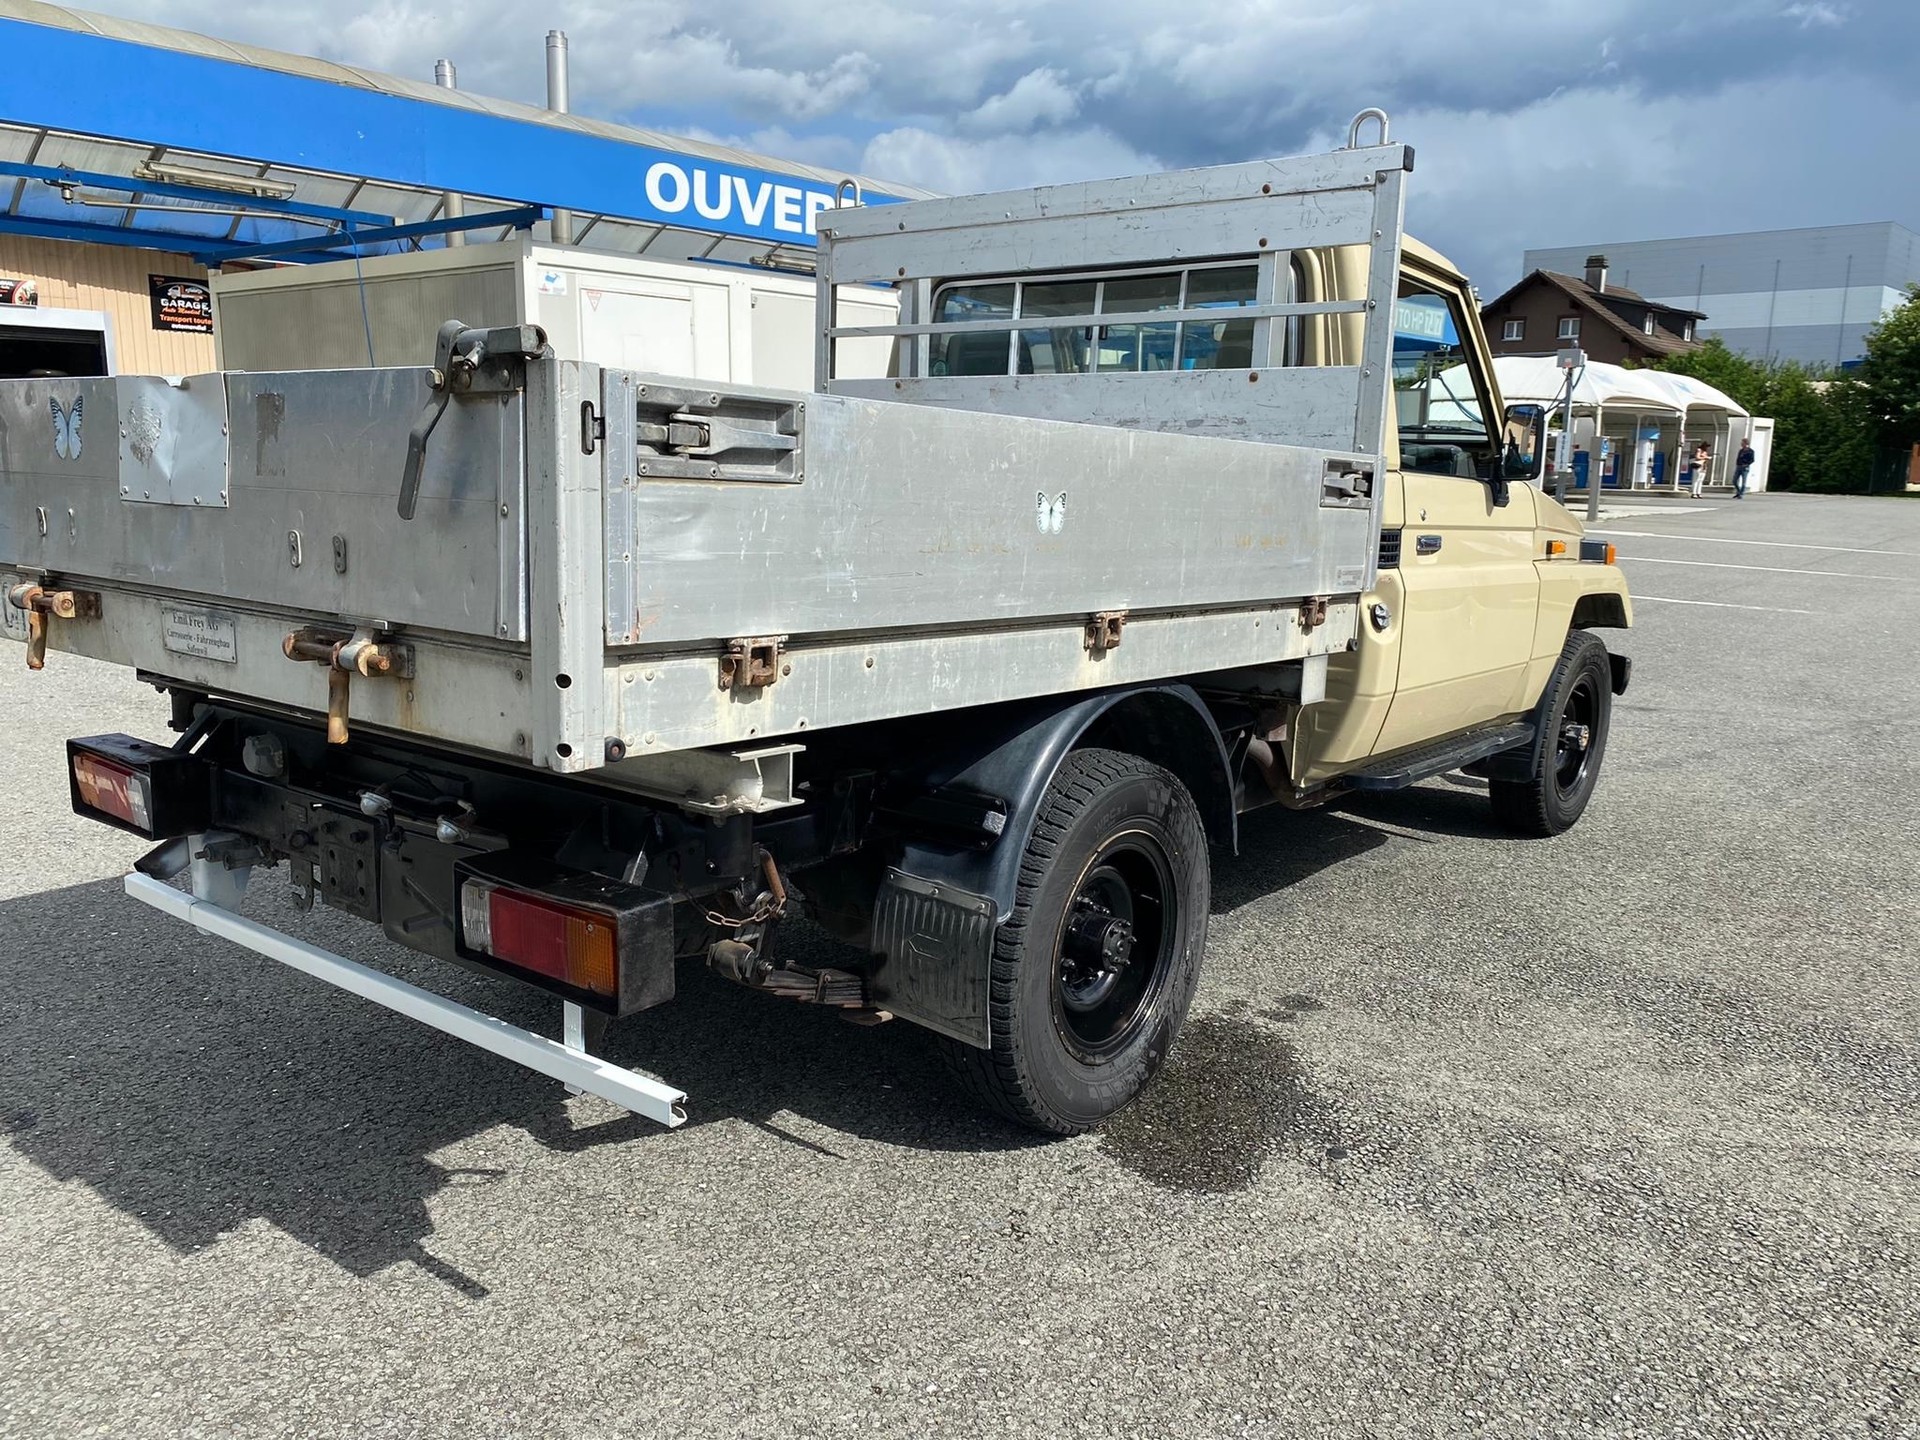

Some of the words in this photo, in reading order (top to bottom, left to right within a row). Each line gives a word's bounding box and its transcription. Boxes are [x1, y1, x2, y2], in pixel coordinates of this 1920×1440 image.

[645, 162, 867, 236] OUVER
[160, 298, 209, 310] GARAGE
[160, 314, 192, 323] Transport
[189, 614, 204, 631] Frey
[207, 619, 218, 631] AG
